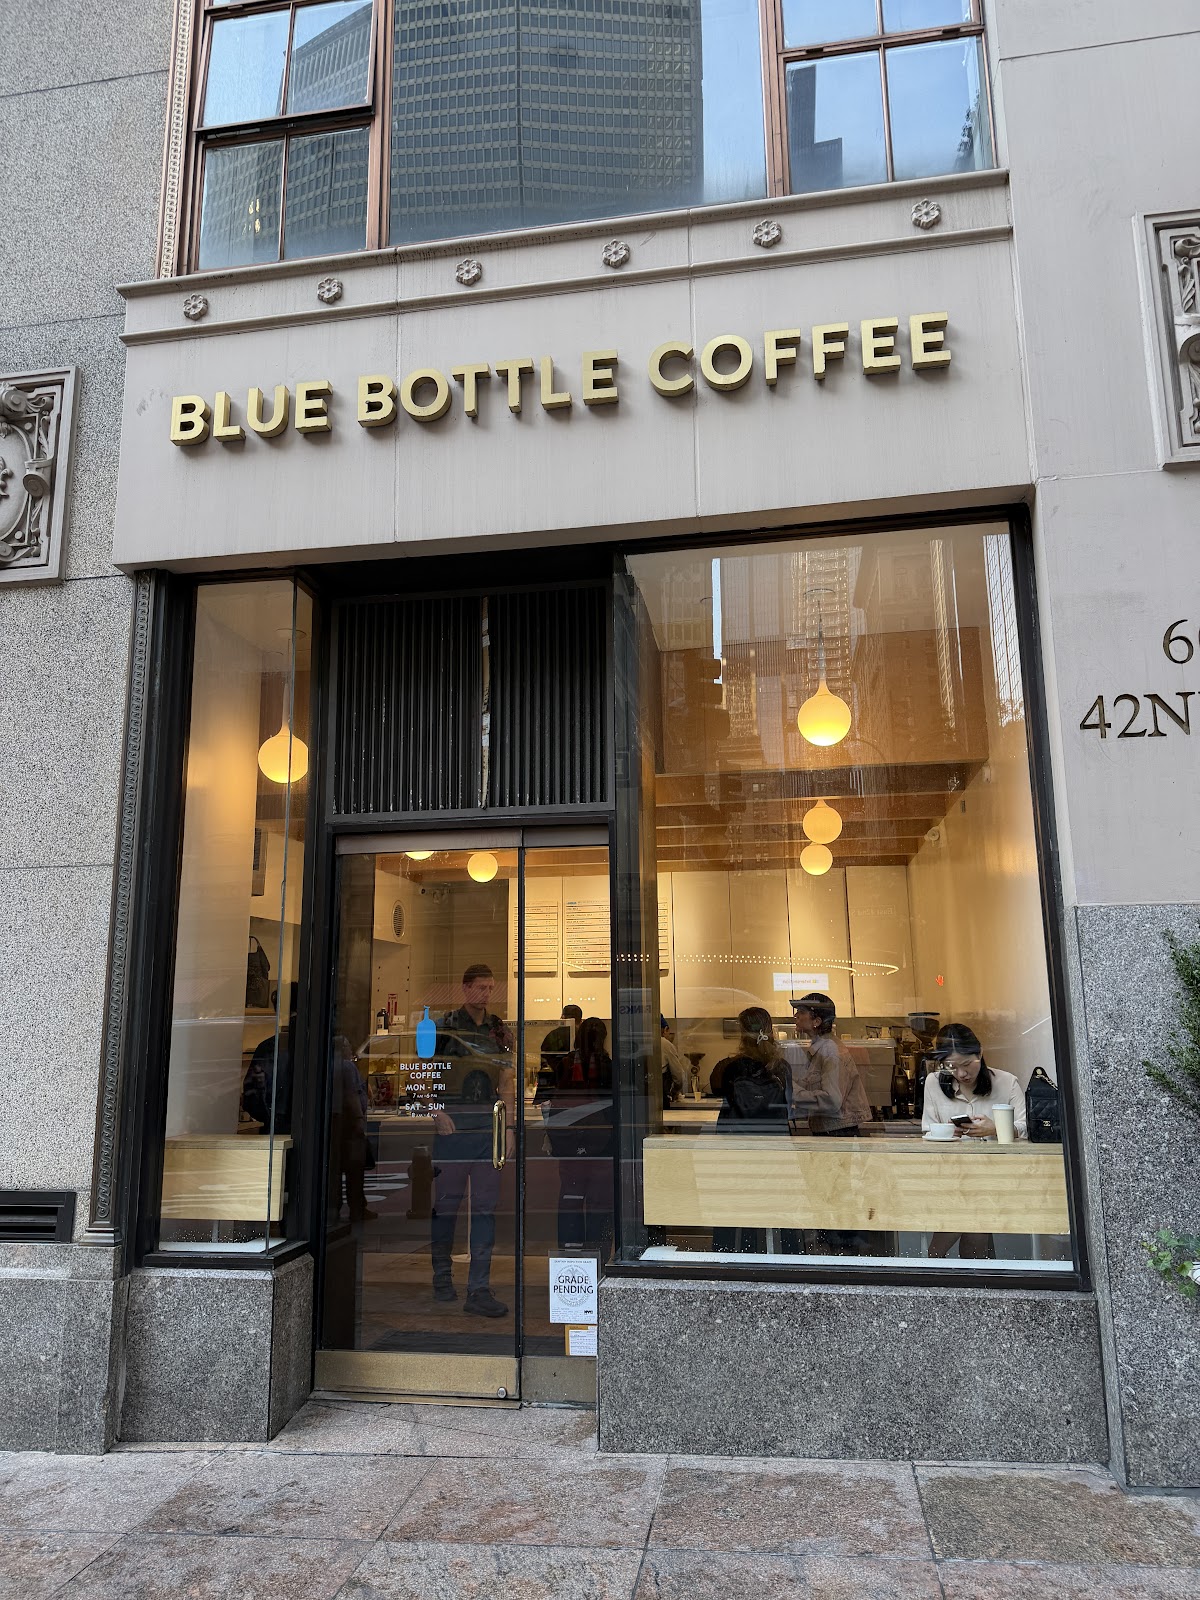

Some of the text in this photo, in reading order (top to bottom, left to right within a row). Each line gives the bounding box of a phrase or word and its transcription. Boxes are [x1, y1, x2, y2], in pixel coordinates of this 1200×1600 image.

[168, 310, 953, 448] BLUE BOTTLE COFFEE
[1162, 619, 1200, 664] 6
[1080, 691, 1200, 739] 42N
[553, 1285, 594, 1294] PENDING
[558, 1276, 589, 1284] GRADE
